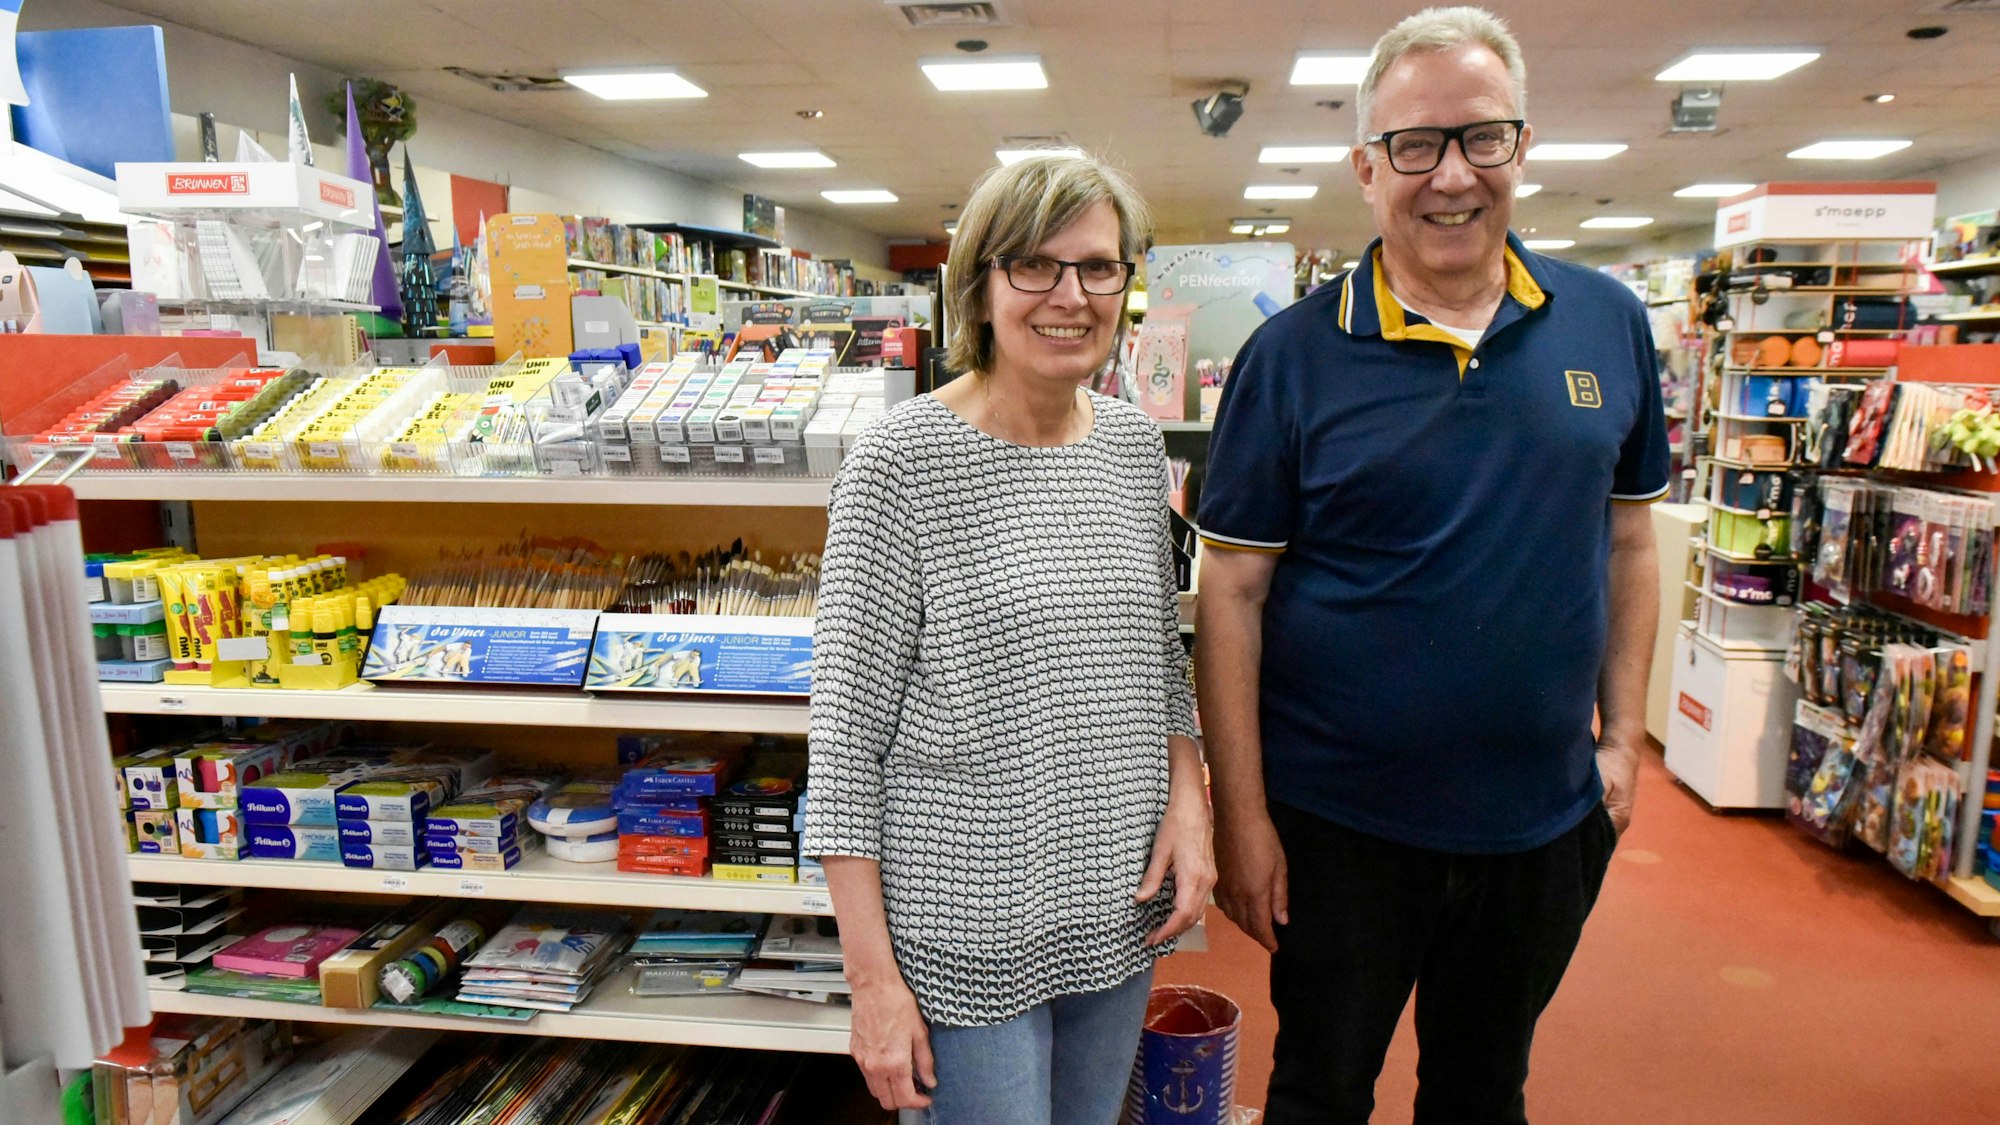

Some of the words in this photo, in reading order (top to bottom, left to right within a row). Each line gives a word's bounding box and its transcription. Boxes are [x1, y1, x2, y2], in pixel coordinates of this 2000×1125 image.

[172, 177, 229, 190] BRUNNEN
[1179, 273, 1261, 288] PENfection
[490, 381, 514, 389] UHU
[179, 636, 190, 658] UHU
[194, 638, 202, 658] UHU
[247, 803, 276, 812] Pelikan
[428, 823, 450, 831] Pelikan
[254, 836, 282, 847] Pelikan
